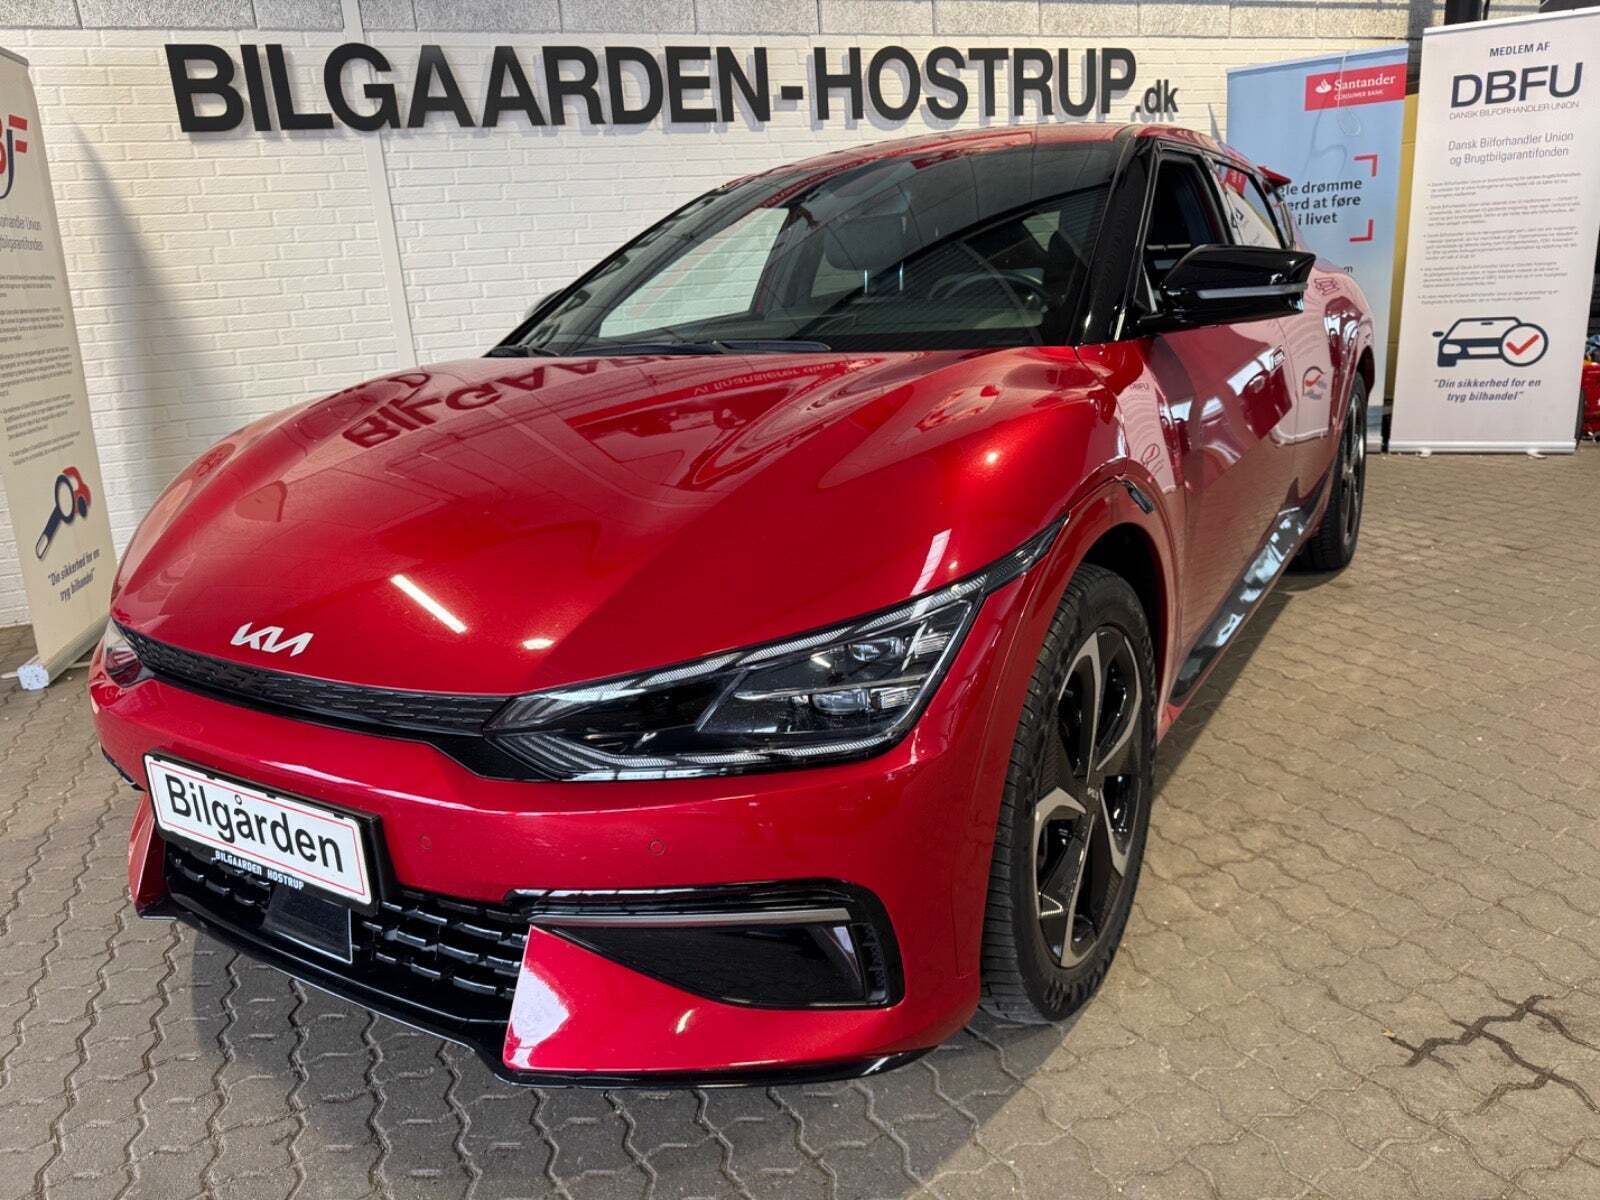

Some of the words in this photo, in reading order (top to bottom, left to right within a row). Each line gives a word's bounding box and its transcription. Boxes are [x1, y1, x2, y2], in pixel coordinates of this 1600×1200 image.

[1489, 43, 1533, 57] MEDLEM
[1536, 42, 1550, 52] AF
[1334, 73, 1396, 91] Santander
[1451, 62, 1583, 108] DBFU
[1367, 89, 1384, 97] BANK
[1449, 110, 1478, 120] DANSK
[1480, 104, 1550, 117] BILFORHANDLER
[1551, 101, 1579, 110] UNION
[1448, 140, 1477, 151] Dansk
[1479, 134, 1542, 148] Bilforhandler
[1545, 132, 1574, 143] Union
[1449, 157, 1464, 167] og
[1464, 147, 1569, 165] Brugtbilgarantifonden
[1301, 180, 1362, 194] drømme
[1313, 198, 1327, 209] at
[1332, 195, 1361, 208] føre
[1298, 213, 1302, 226] i
[1306, 212, 1338, 225] livet
[1456, 378, 1508, 388] sikkerhed
[1511, 378, 1525, 388] for
[1528, 379, 1541, 387] en
[1446, 393, 1466, 402] tryg
[230, 622, 314, 657] KIA
[165, 774, 344, 873] Bilgården
[267, 868, 304, 891] HOSTRUP
